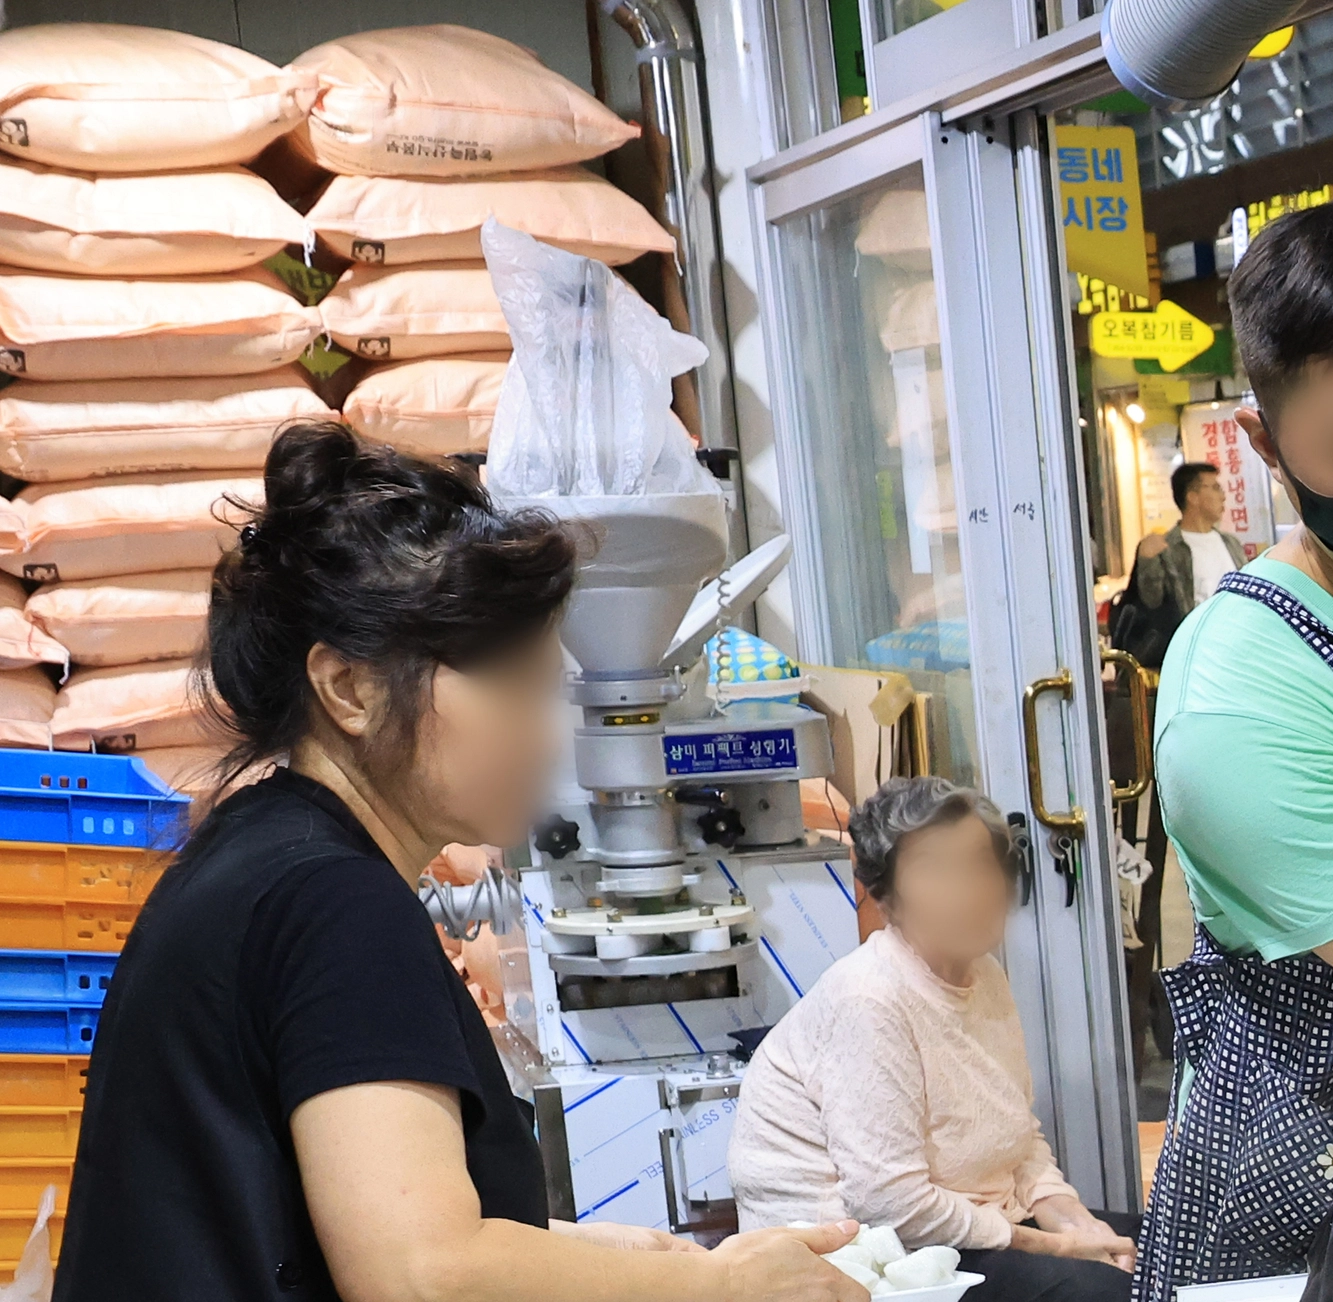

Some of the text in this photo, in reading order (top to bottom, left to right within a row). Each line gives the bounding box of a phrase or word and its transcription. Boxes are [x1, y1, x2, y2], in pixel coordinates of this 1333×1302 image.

[1057, 147, 1124, 183] 동네
[1064, 196, 1129, 232] 시장
[1102, 318, 1195, 341] 오복참기름
[669, 744, 698, 761] 삼미
